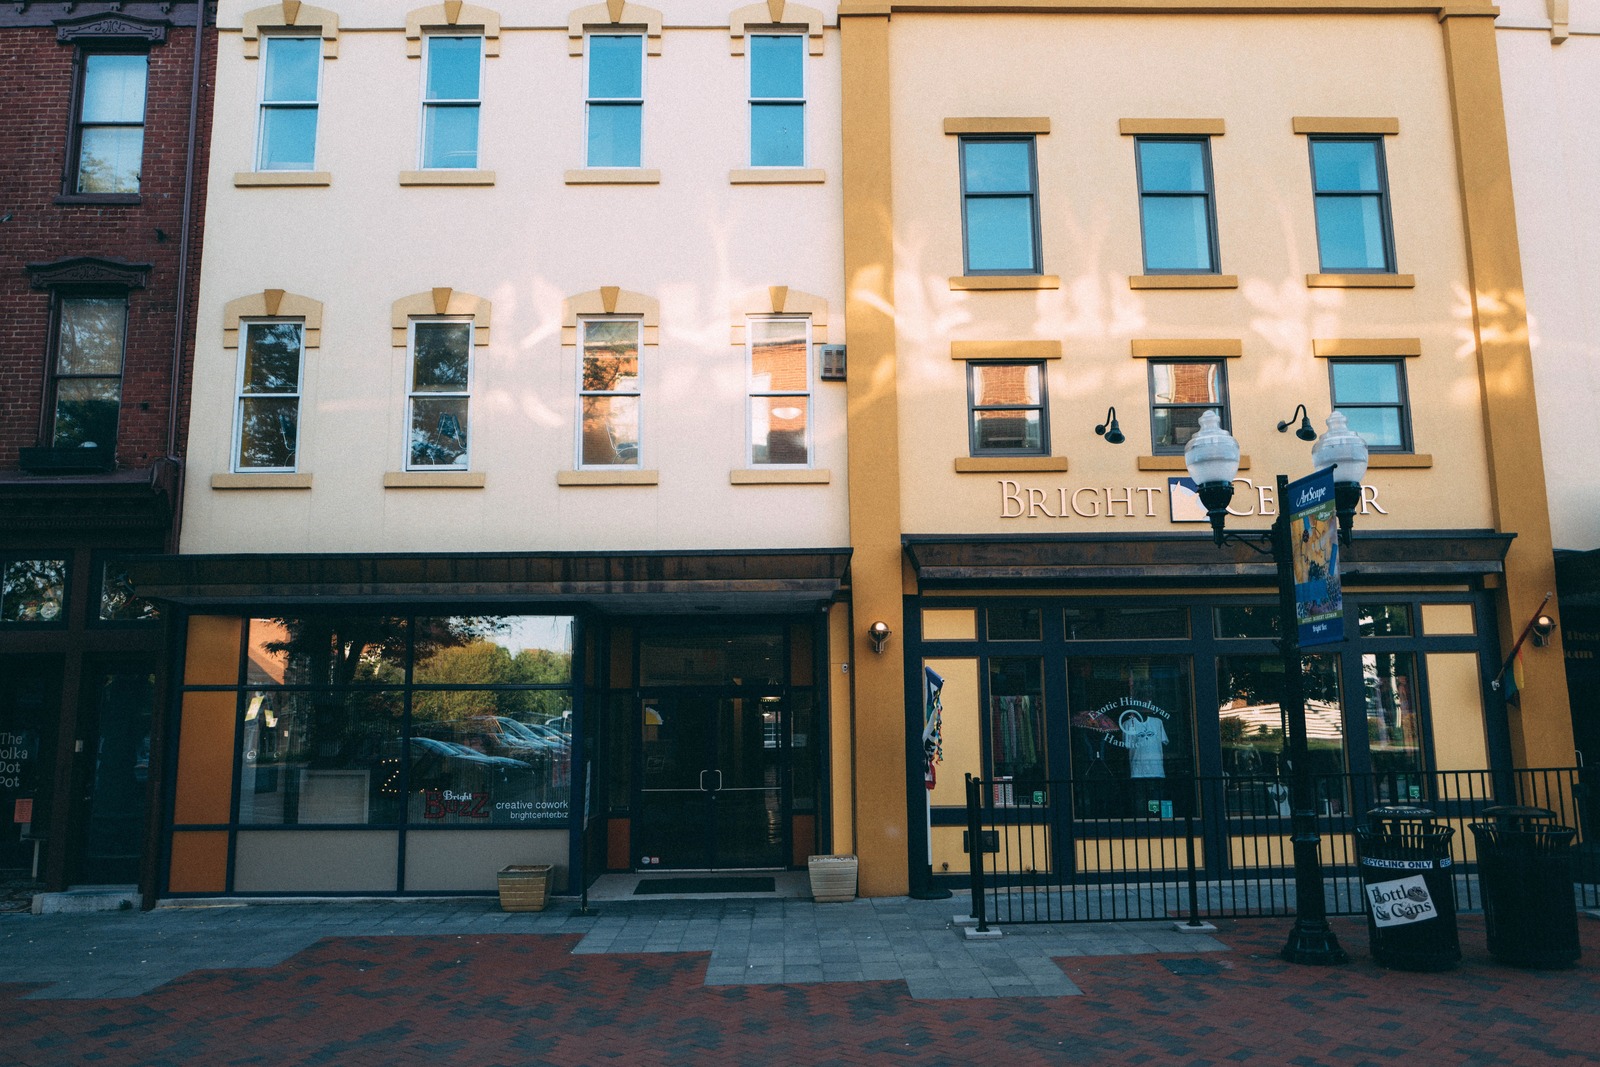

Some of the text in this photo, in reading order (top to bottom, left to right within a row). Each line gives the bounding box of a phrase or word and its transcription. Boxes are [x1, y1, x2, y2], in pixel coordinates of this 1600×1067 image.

[999, 478, 1388, 518] BRIGHT CER
[1088, 696, 1171, 720] Exotic Himalayan
[0, 732, 23, 745] The
[0, 747, 28, 760] olka
[0, 761, 21, 773] Dot
[442, 790, 472, 802] Bright
[495, 800, 569, 809] creative cowork
[1371, 885, 1424, 903] Bottles
[1375, 901, 1432, 921] & Cans
